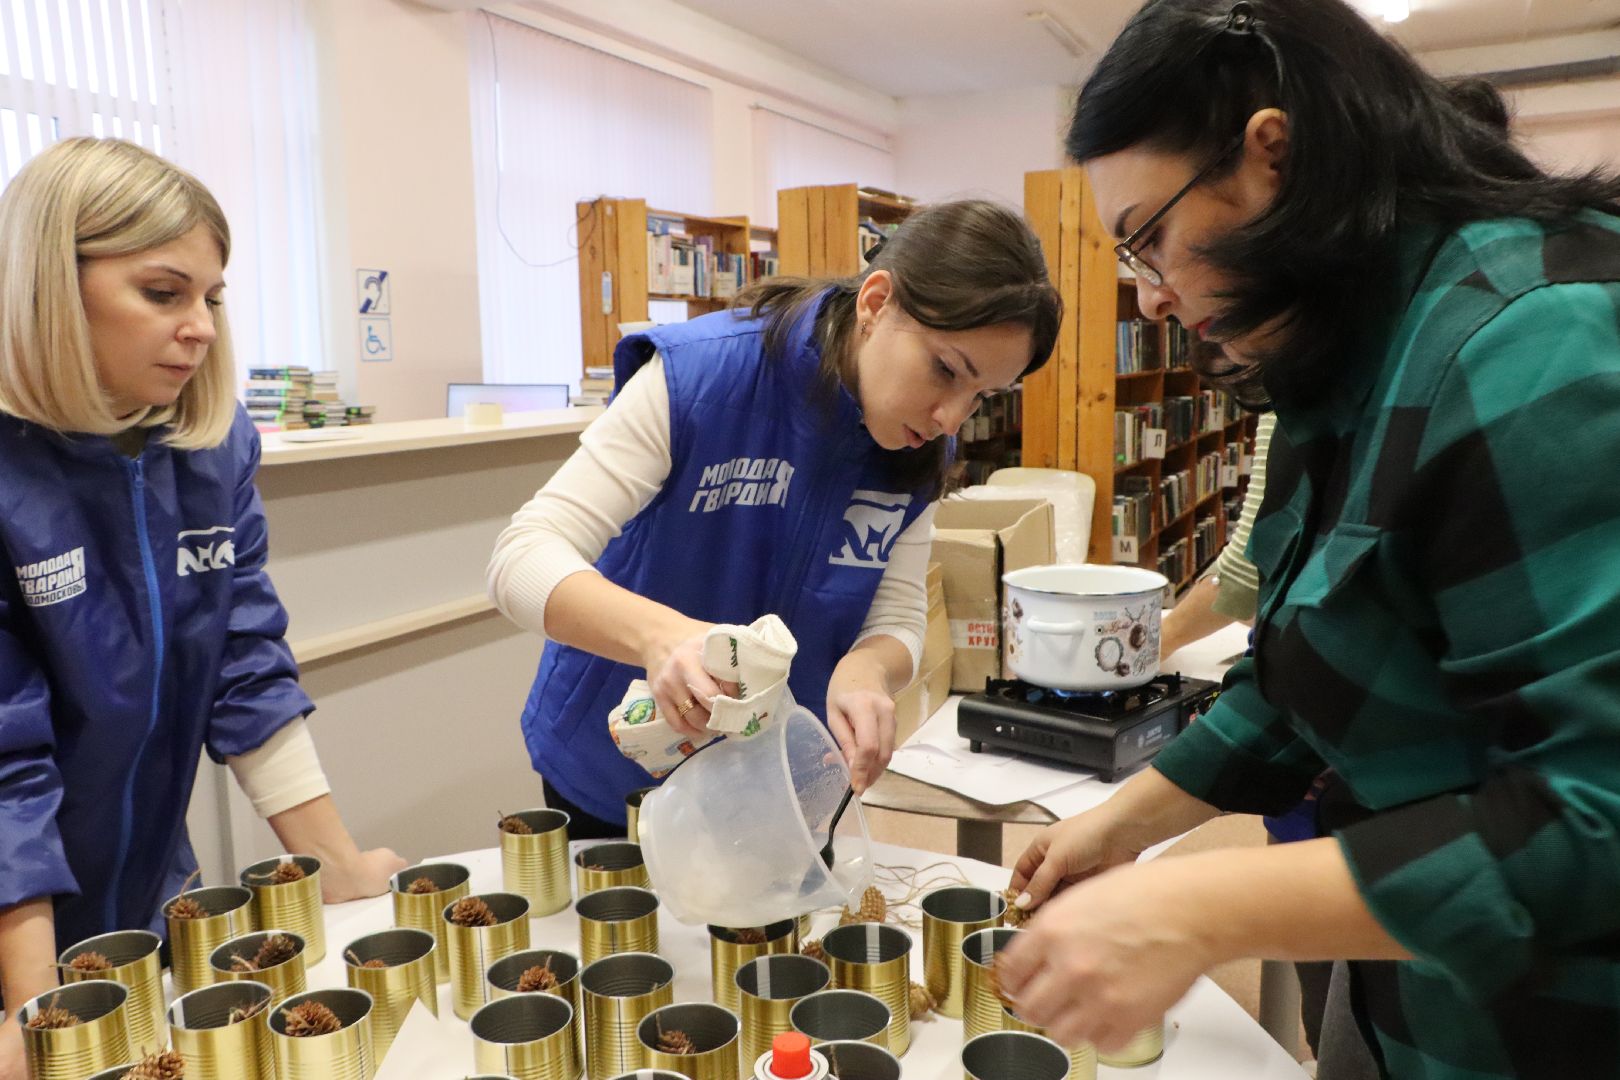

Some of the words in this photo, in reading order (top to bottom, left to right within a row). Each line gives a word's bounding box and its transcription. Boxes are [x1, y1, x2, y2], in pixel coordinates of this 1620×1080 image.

[1154, 433, 1163, 447] Л
[1120, 540, 1132, 553] М
[15, 547, 85, 579] МОЛОДАЯ
